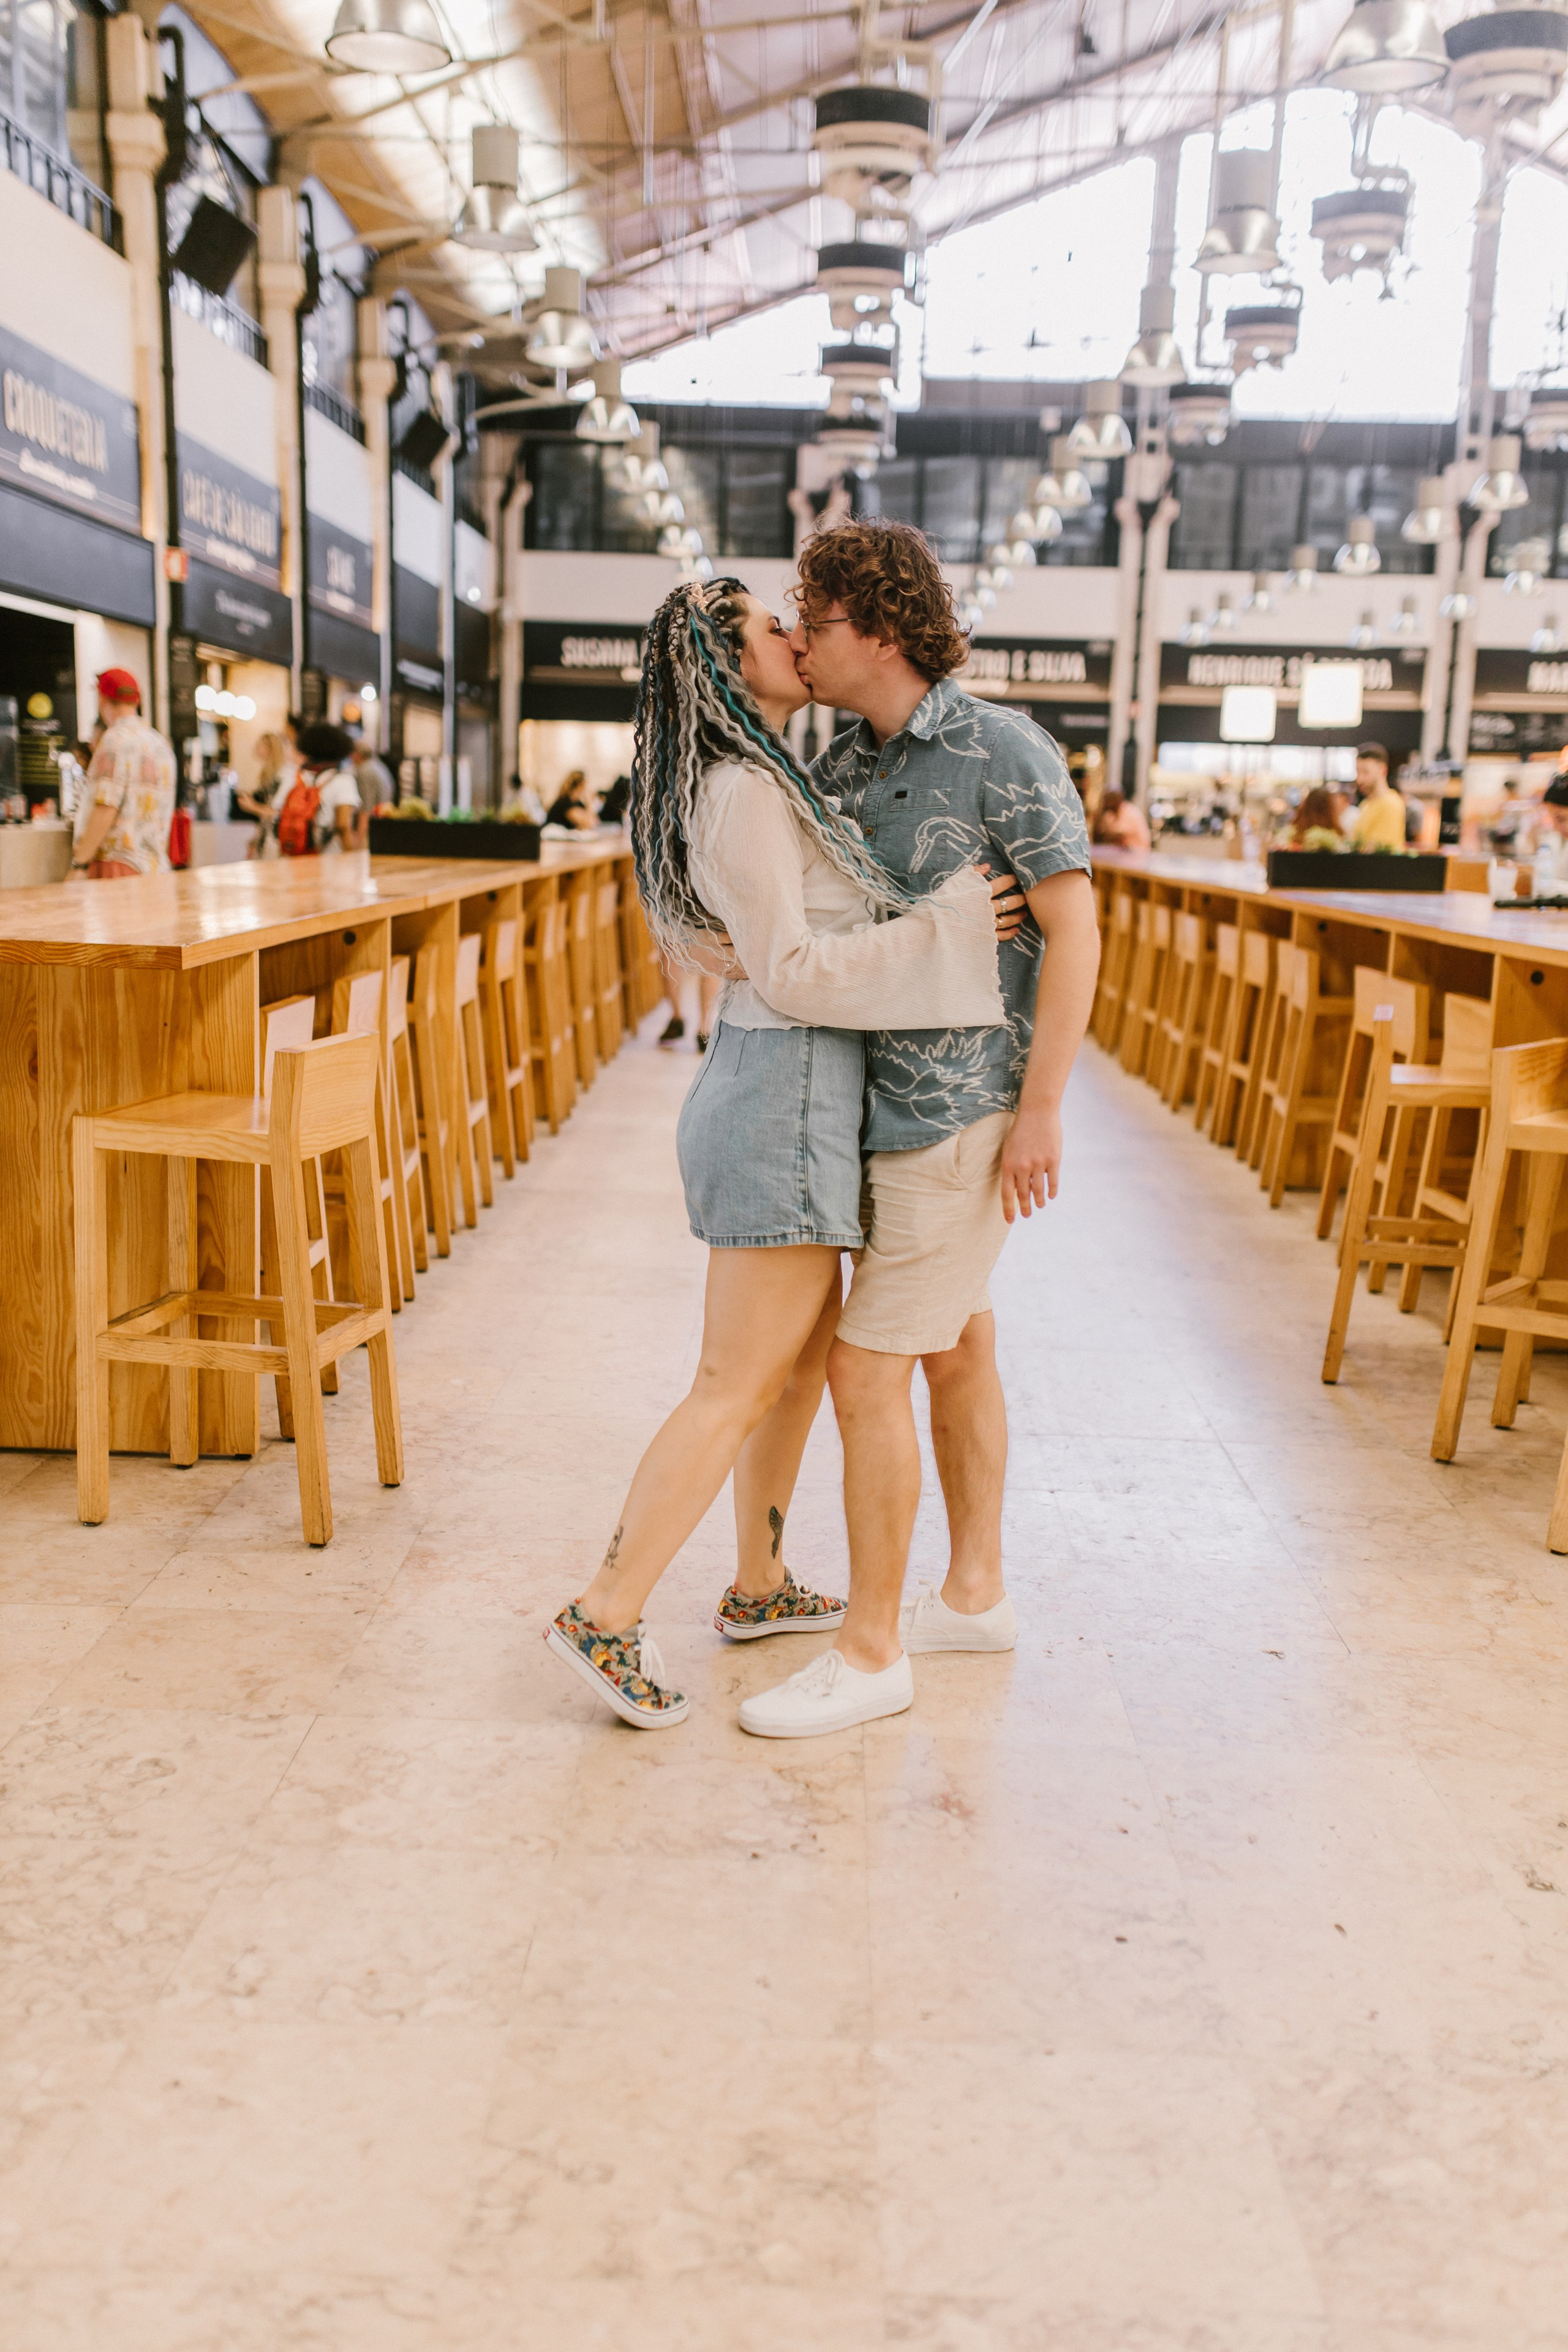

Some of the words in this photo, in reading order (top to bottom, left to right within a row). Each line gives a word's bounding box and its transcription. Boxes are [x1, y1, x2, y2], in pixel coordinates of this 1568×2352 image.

[561, 636, 638, 668] SUSANA
[1011, 649, 1027, 681] E
[1027, 649, 1087, 683] SILVA
[1187, 654, 1285, 687] HENRIQUE
